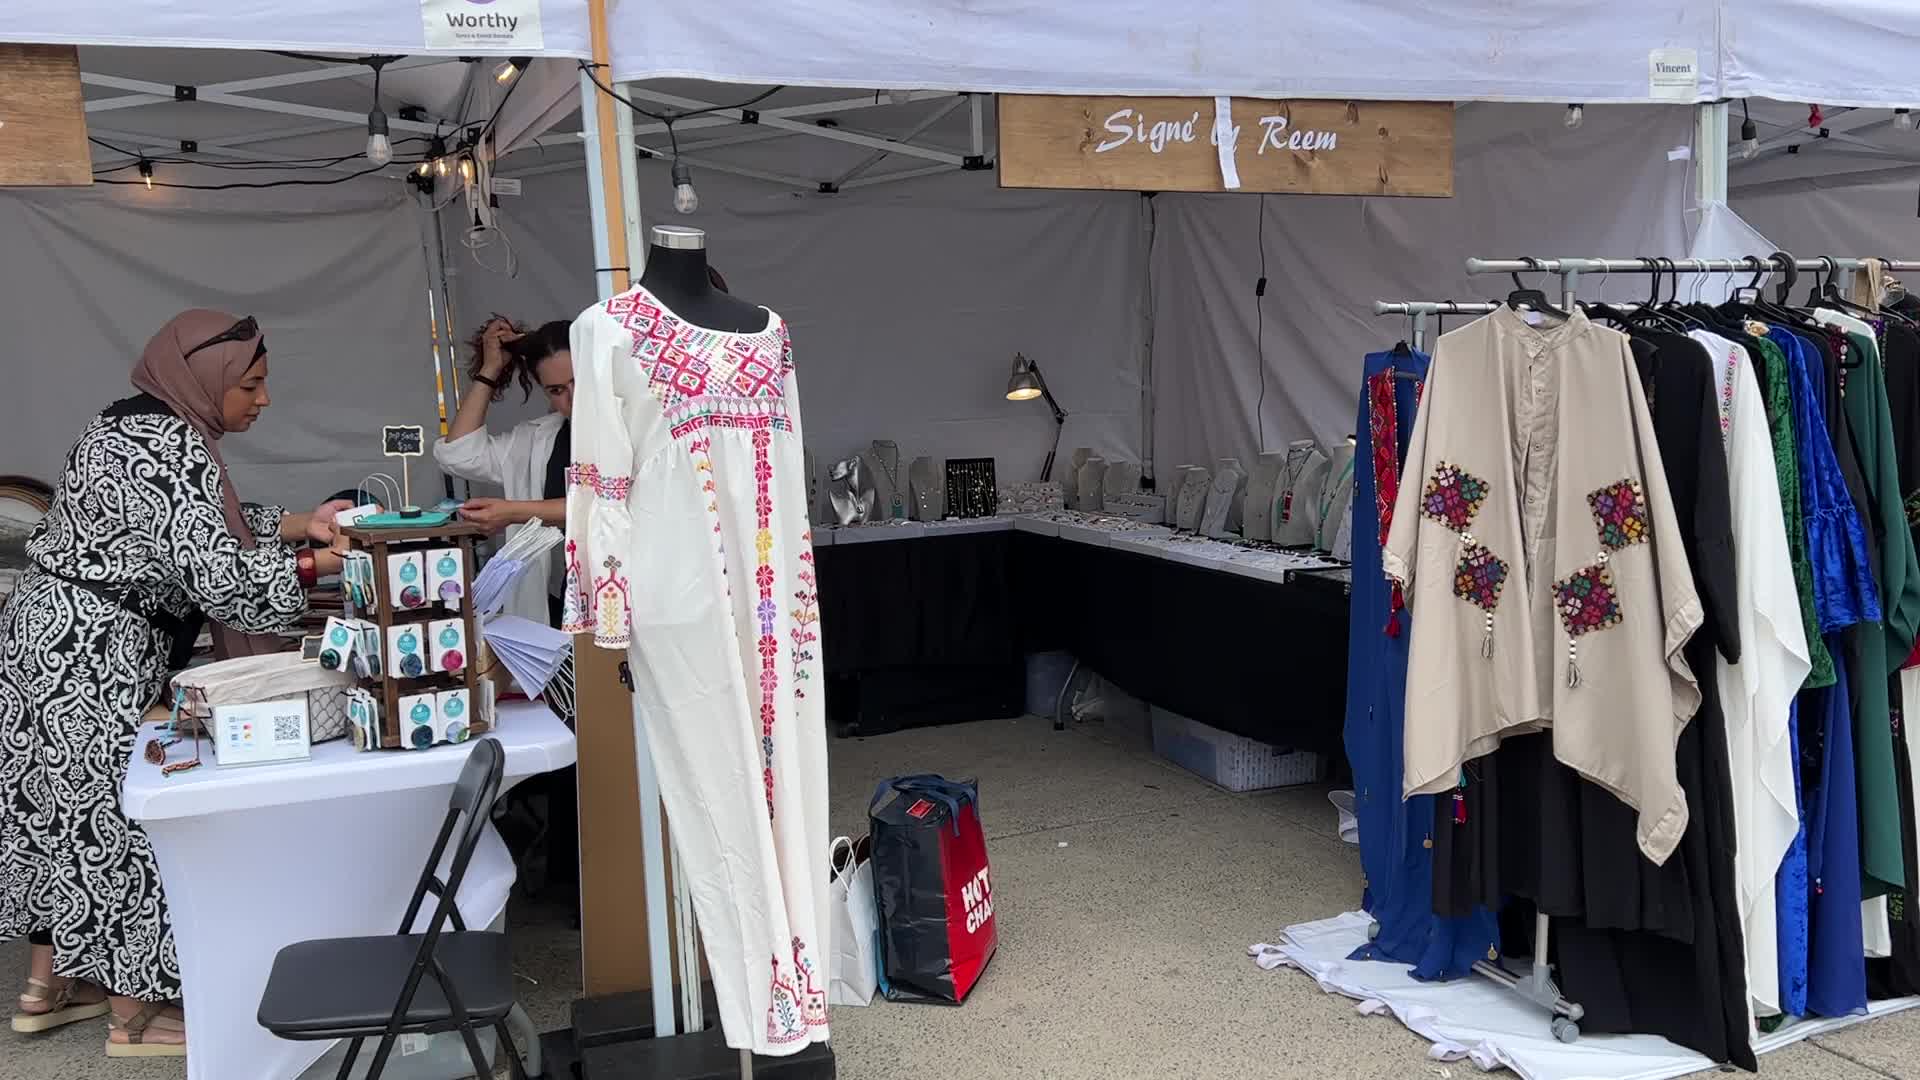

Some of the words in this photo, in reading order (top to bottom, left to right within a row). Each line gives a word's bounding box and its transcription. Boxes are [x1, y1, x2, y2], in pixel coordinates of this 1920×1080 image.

[446, 12, 519, 32] Worthy
[1655, 62, 1691, 73] Vincent
[1095, 108, 1200, 154] Signé
[1257, 115, 1337, 155] Reem
[961, 865, 990, 913] HOT
[966, 893, 993, 934] CHA
